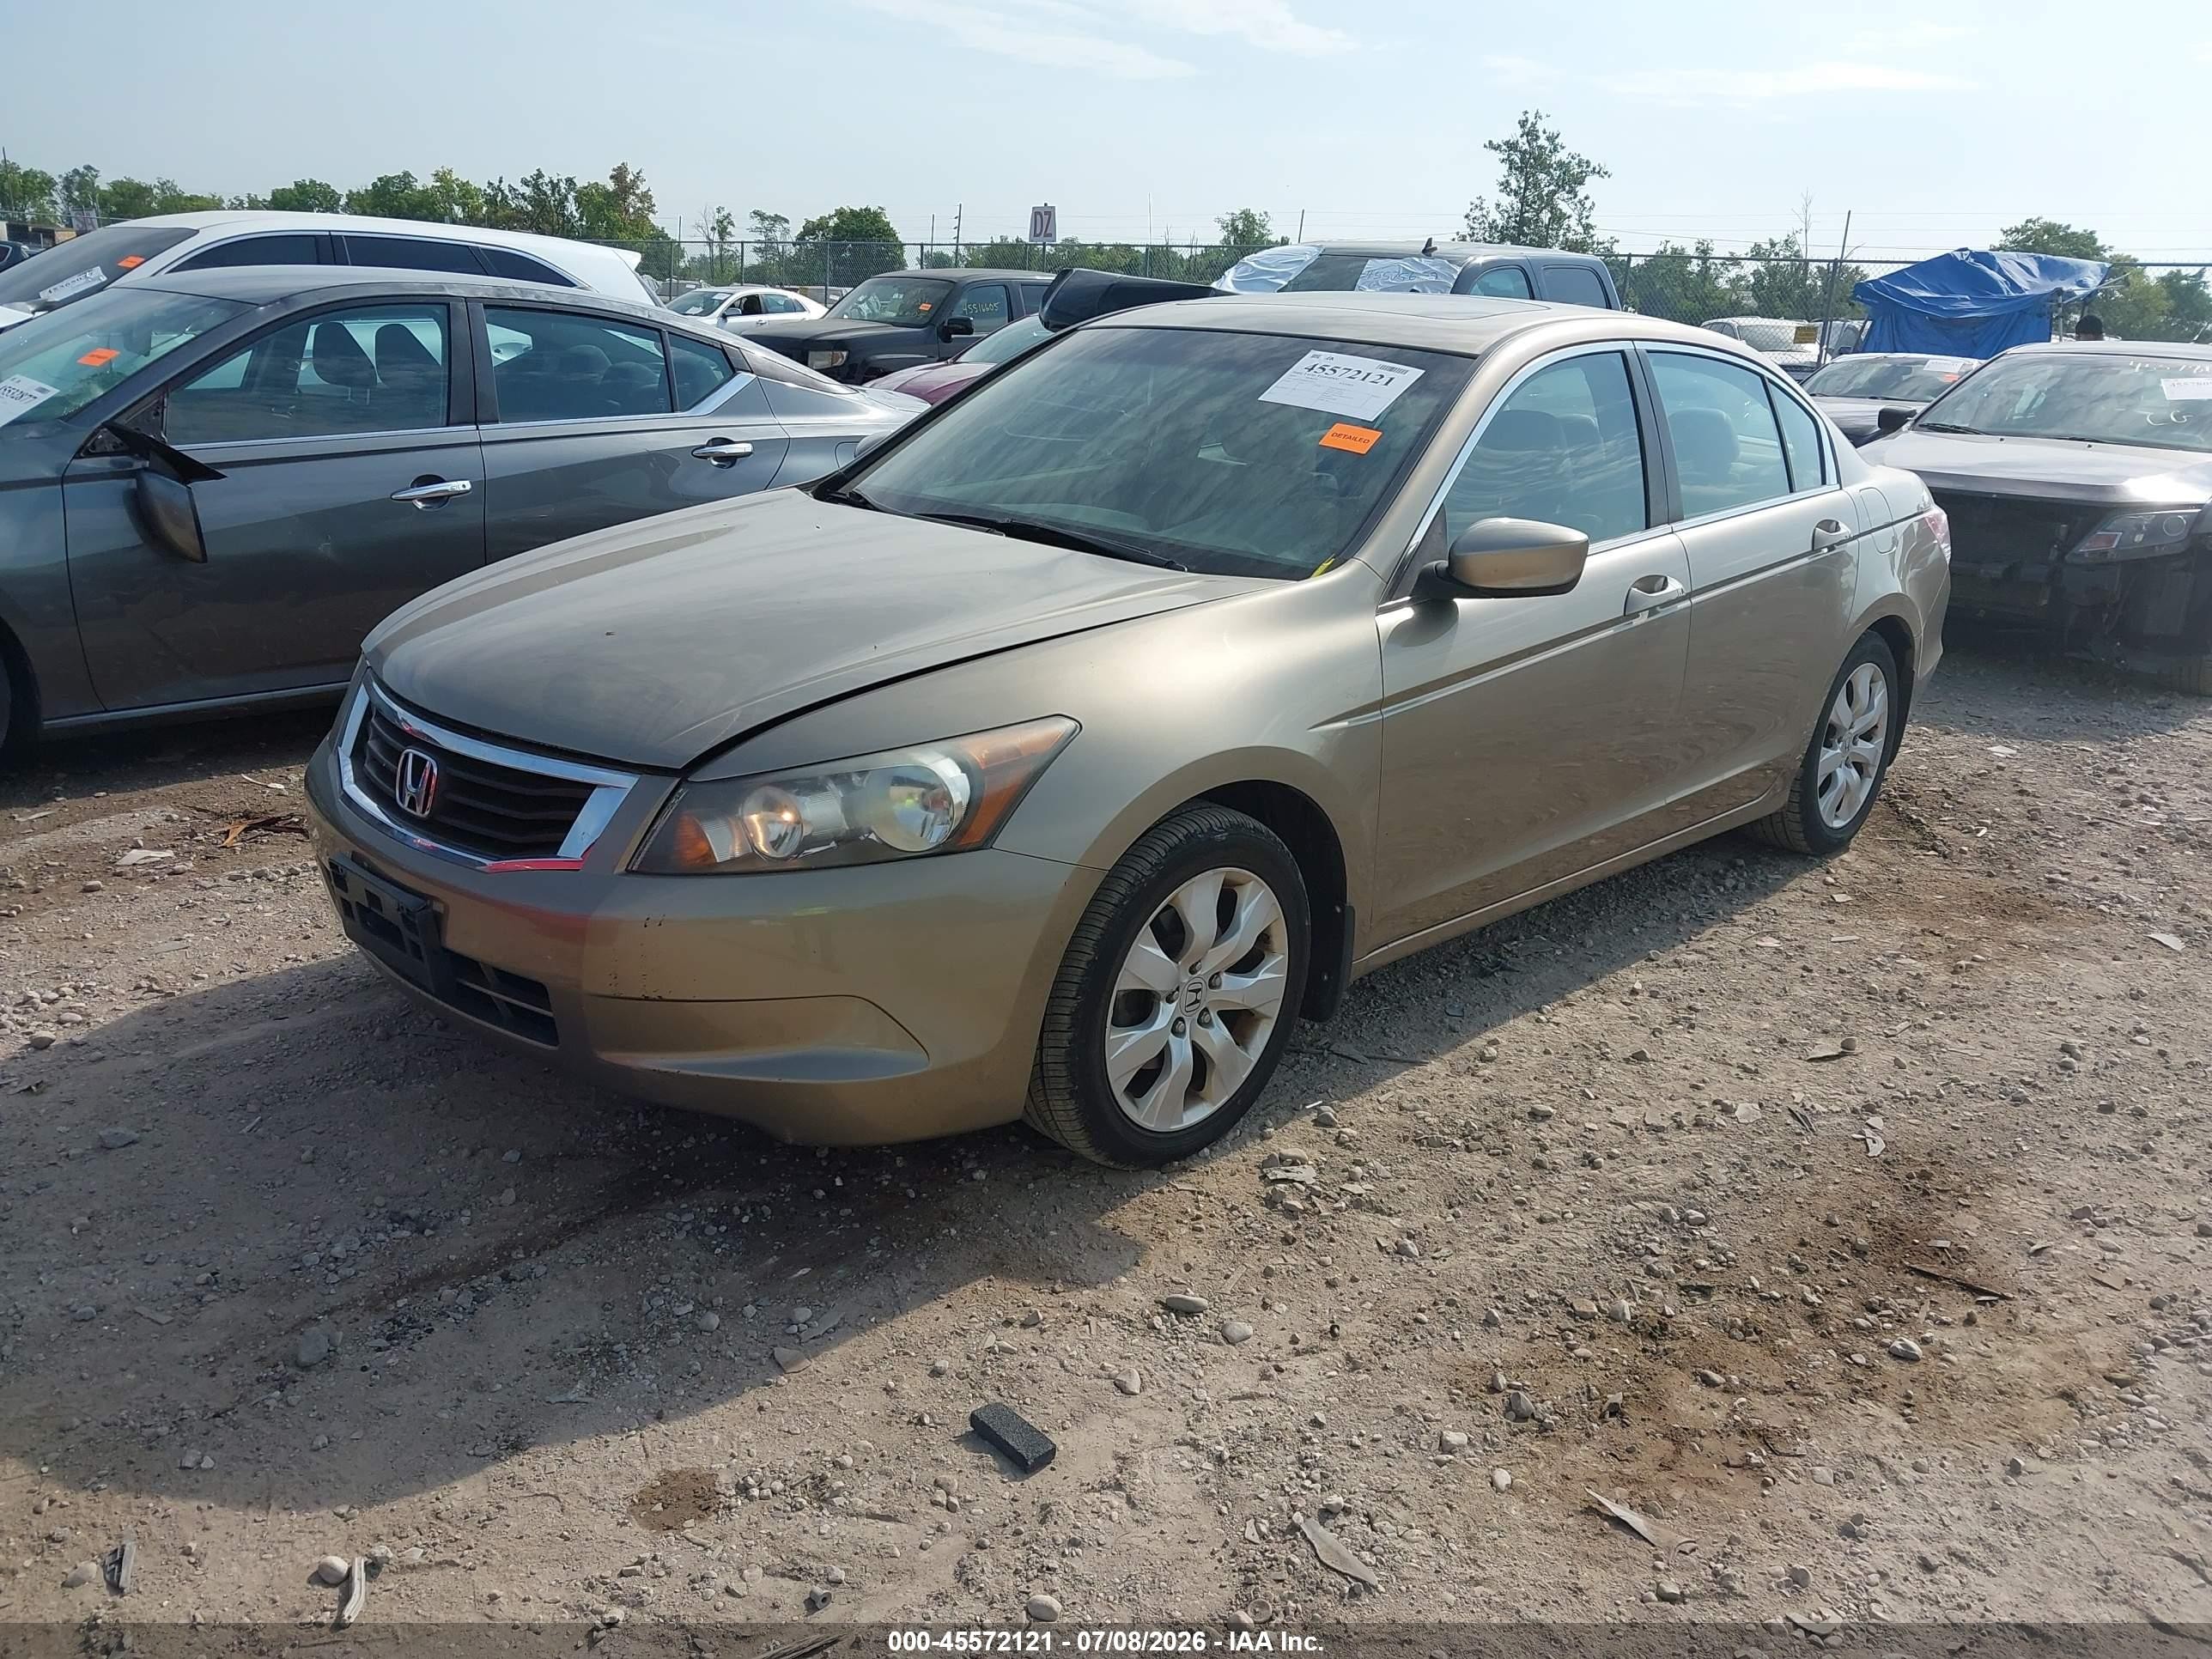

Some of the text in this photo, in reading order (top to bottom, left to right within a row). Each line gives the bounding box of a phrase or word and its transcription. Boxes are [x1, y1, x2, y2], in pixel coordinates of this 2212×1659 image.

[1033, 210, 1053, 238] DZ
[1304, 362, 1395, 386] 45572121
[1331, 432, 1370, 444] DETAILED
